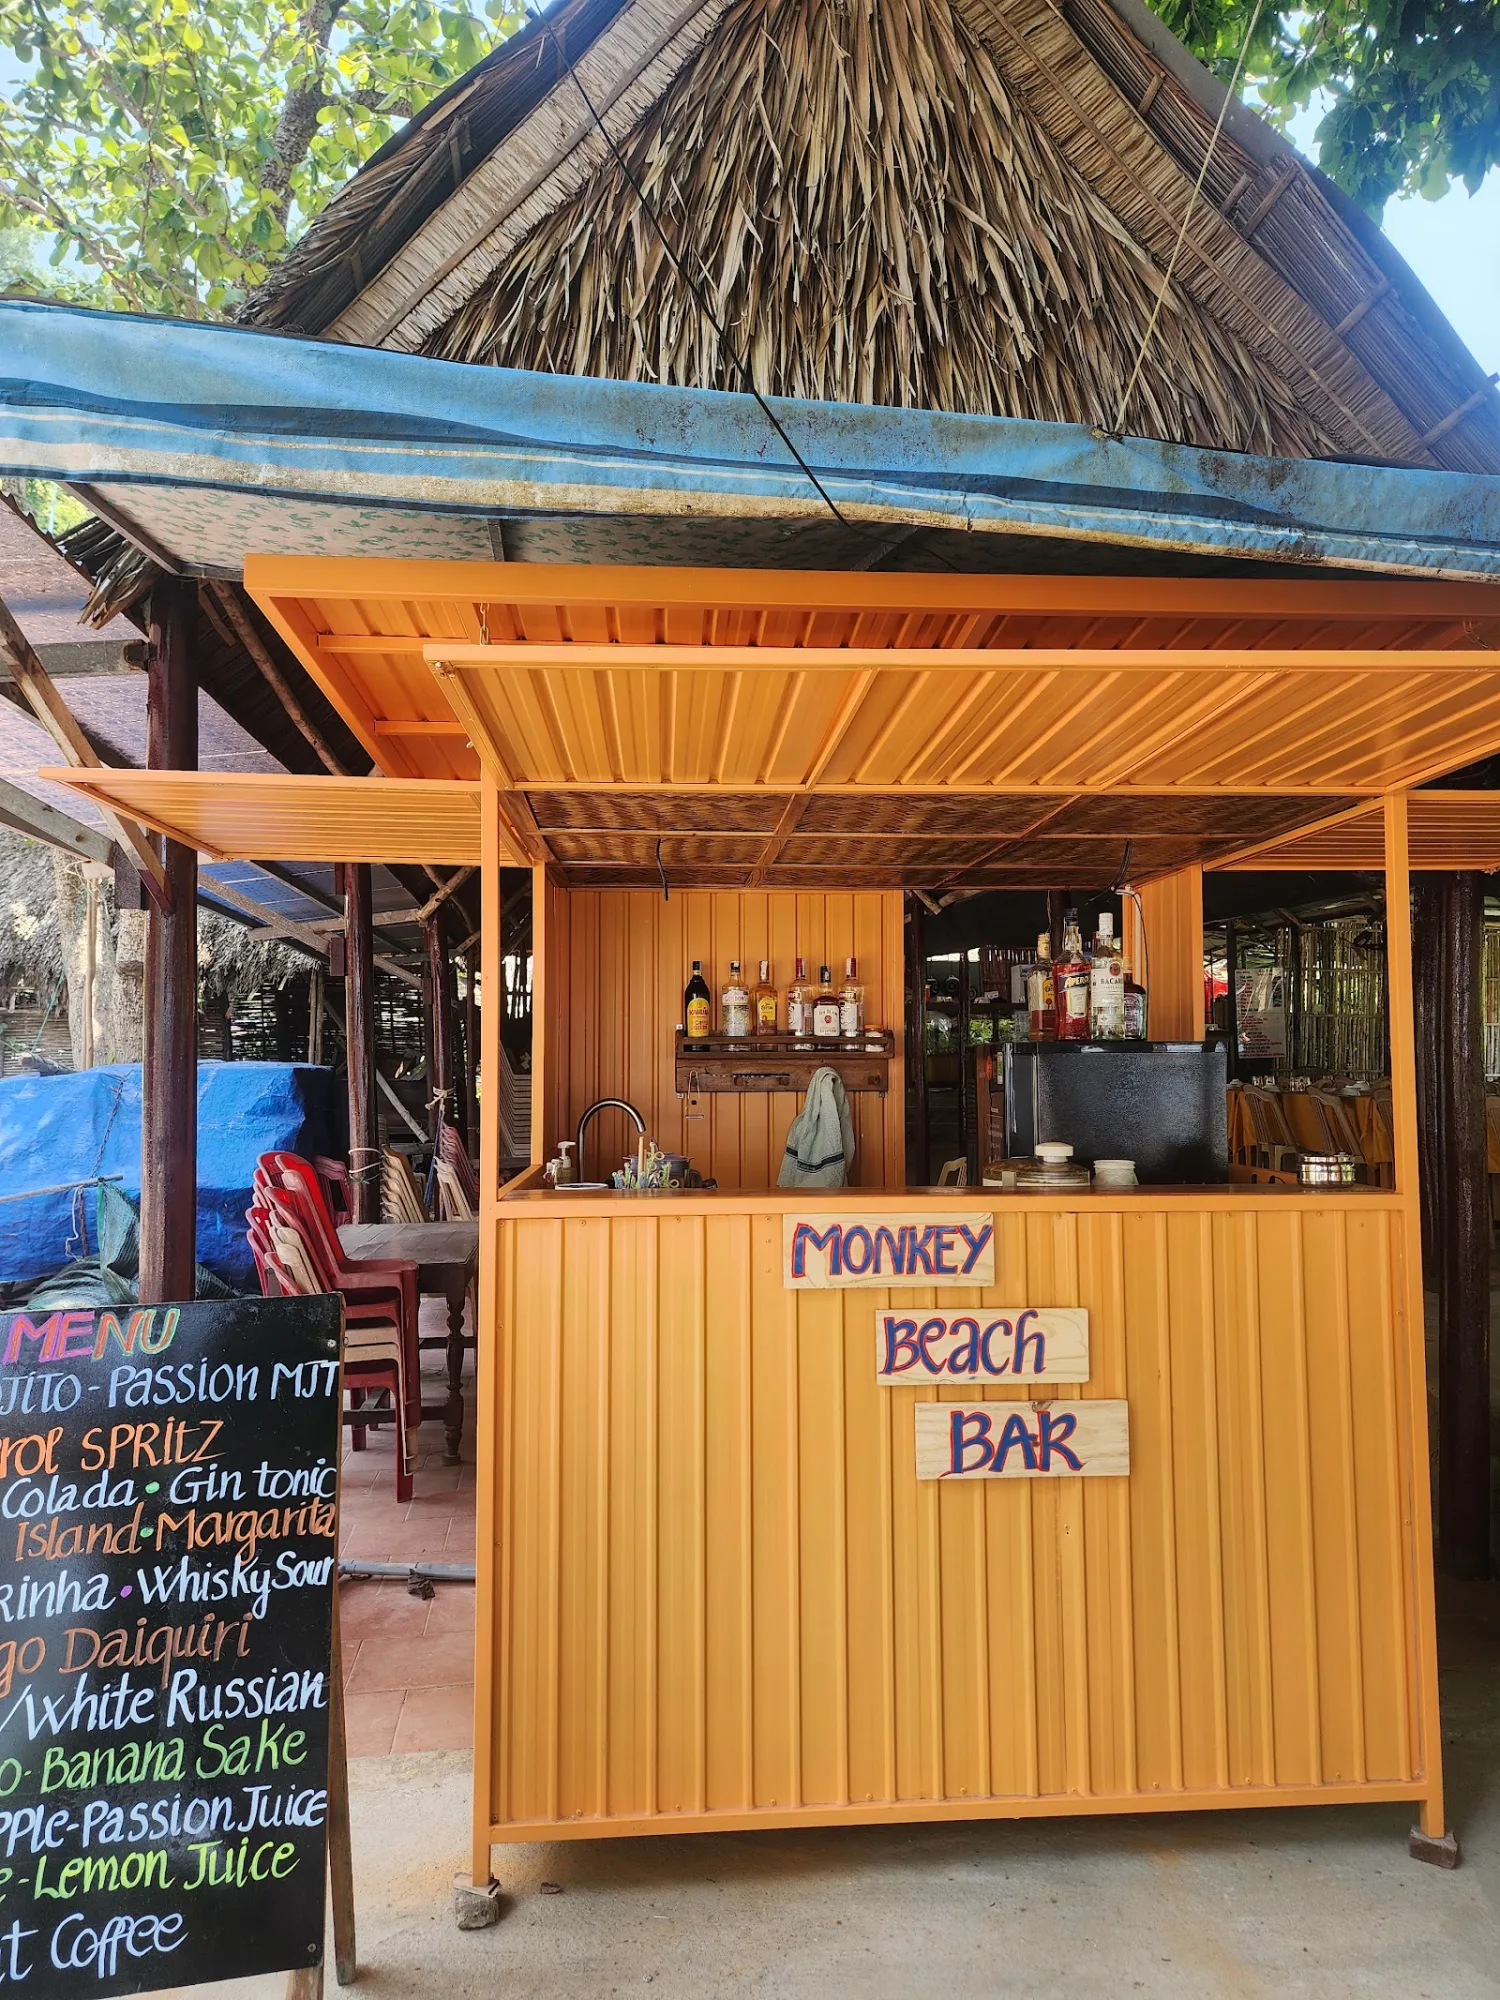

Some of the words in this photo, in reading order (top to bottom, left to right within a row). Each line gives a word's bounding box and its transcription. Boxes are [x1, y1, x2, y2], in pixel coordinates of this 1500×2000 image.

[791, 1222, 994, 1279] MONKEY
[3, 1308, 181, 1364] MENU
[879, 1309, 1047, 1376] Beach
[938, 1410, 1088, 1478] BAR
[2, 1469, 140, 1518] Colada
[169, 1463, 248, 1505] Gin
[252, 1458, 338, 1499] tonic
[14, 1501, 142, 1561] Island
[155, 1496, 336, 1565] Margarita
[58, 1612, 254, 1690] Daiquiri
[166, 1667, 328, 1728] Russian
[196, 1718, 308, 1779] Sake
[183, 1836, 301, 1888] Juice
[50, 1912, 189, 1979] Coffee
